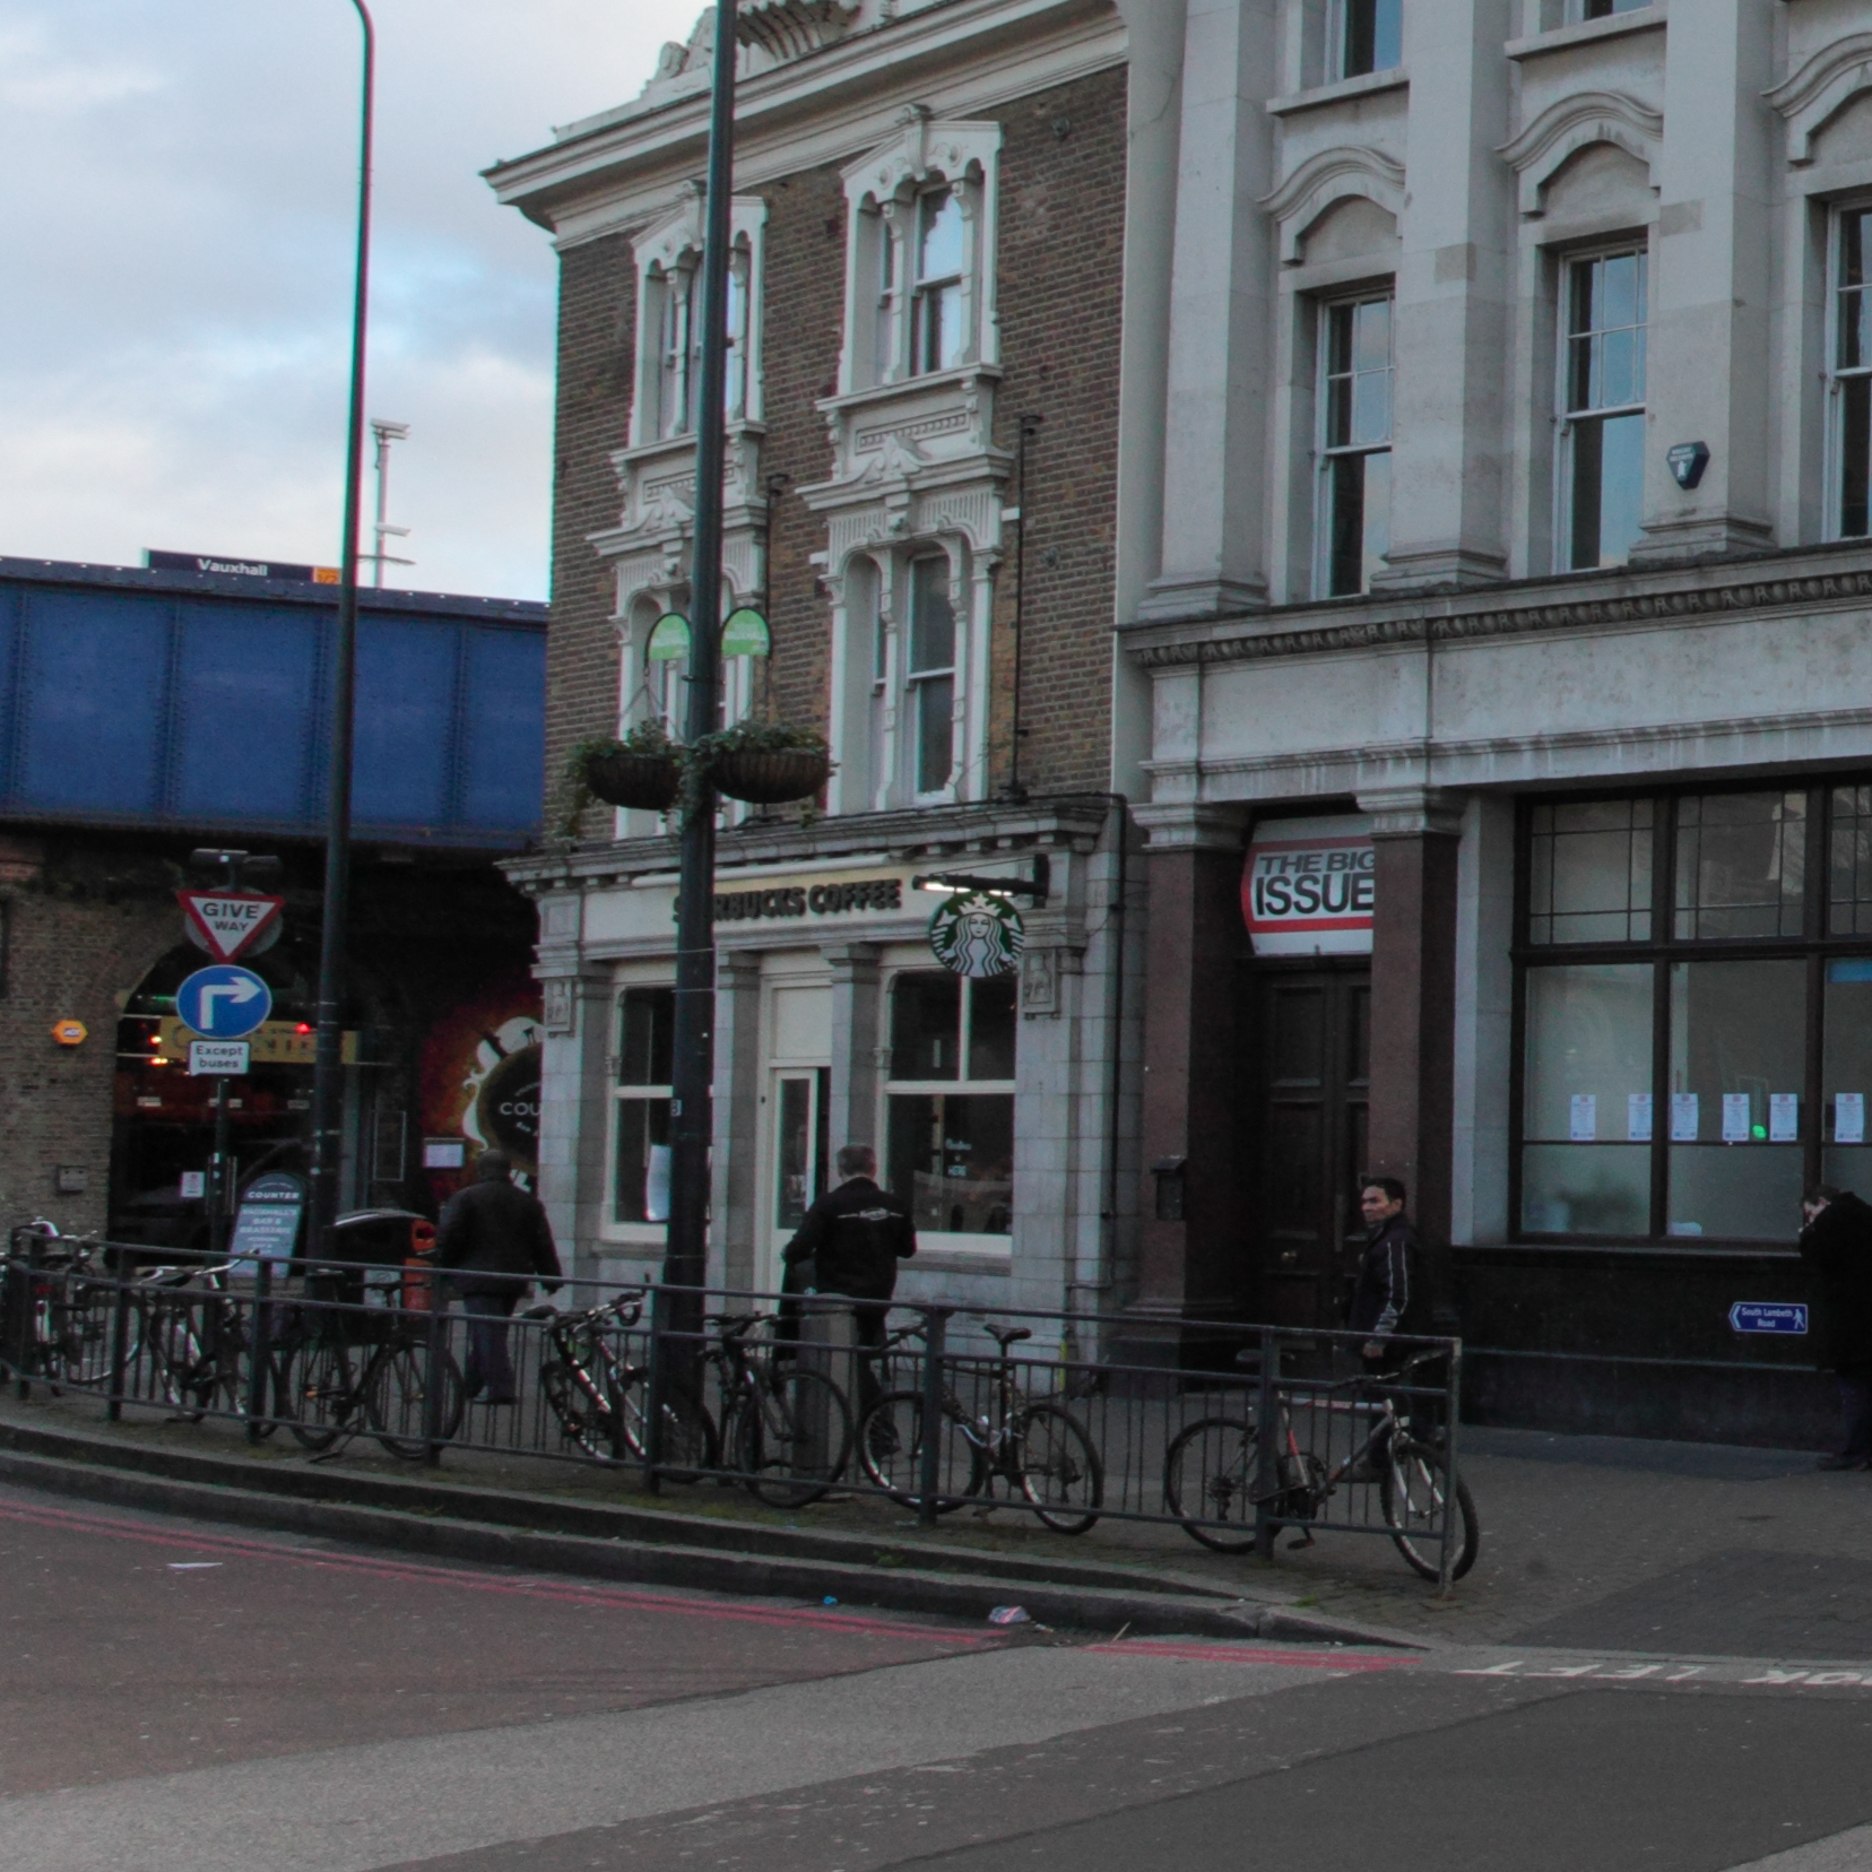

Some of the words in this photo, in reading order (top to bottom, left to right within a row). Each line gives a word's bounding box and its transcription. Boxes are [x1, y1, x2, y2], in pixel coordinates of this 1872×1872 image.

[197, 558, 268, 577] Vauxhall
[1259, 853, 1323, 875] THE
[1326, 849, 1375, 872] BIG
[809, 878, 902, 915] COFFEE
[1255, 872, 1375, 916] ISSUE
[202, 902, 259, 920] GIVE
[214, 920, 249, 932] WAY
[195, 1045, 243, 1057] Except
[199, 1057, 240, 1068] buses
[500, 1102, 542, 1116] COU
[248, 1191, 300, 1200] COUNTER
[1741, 1307, 1762, 1316] South
[1763, 1308, 1793, 1317] Lambeth
[1453, 1660, 1706, 1682] LEFT
